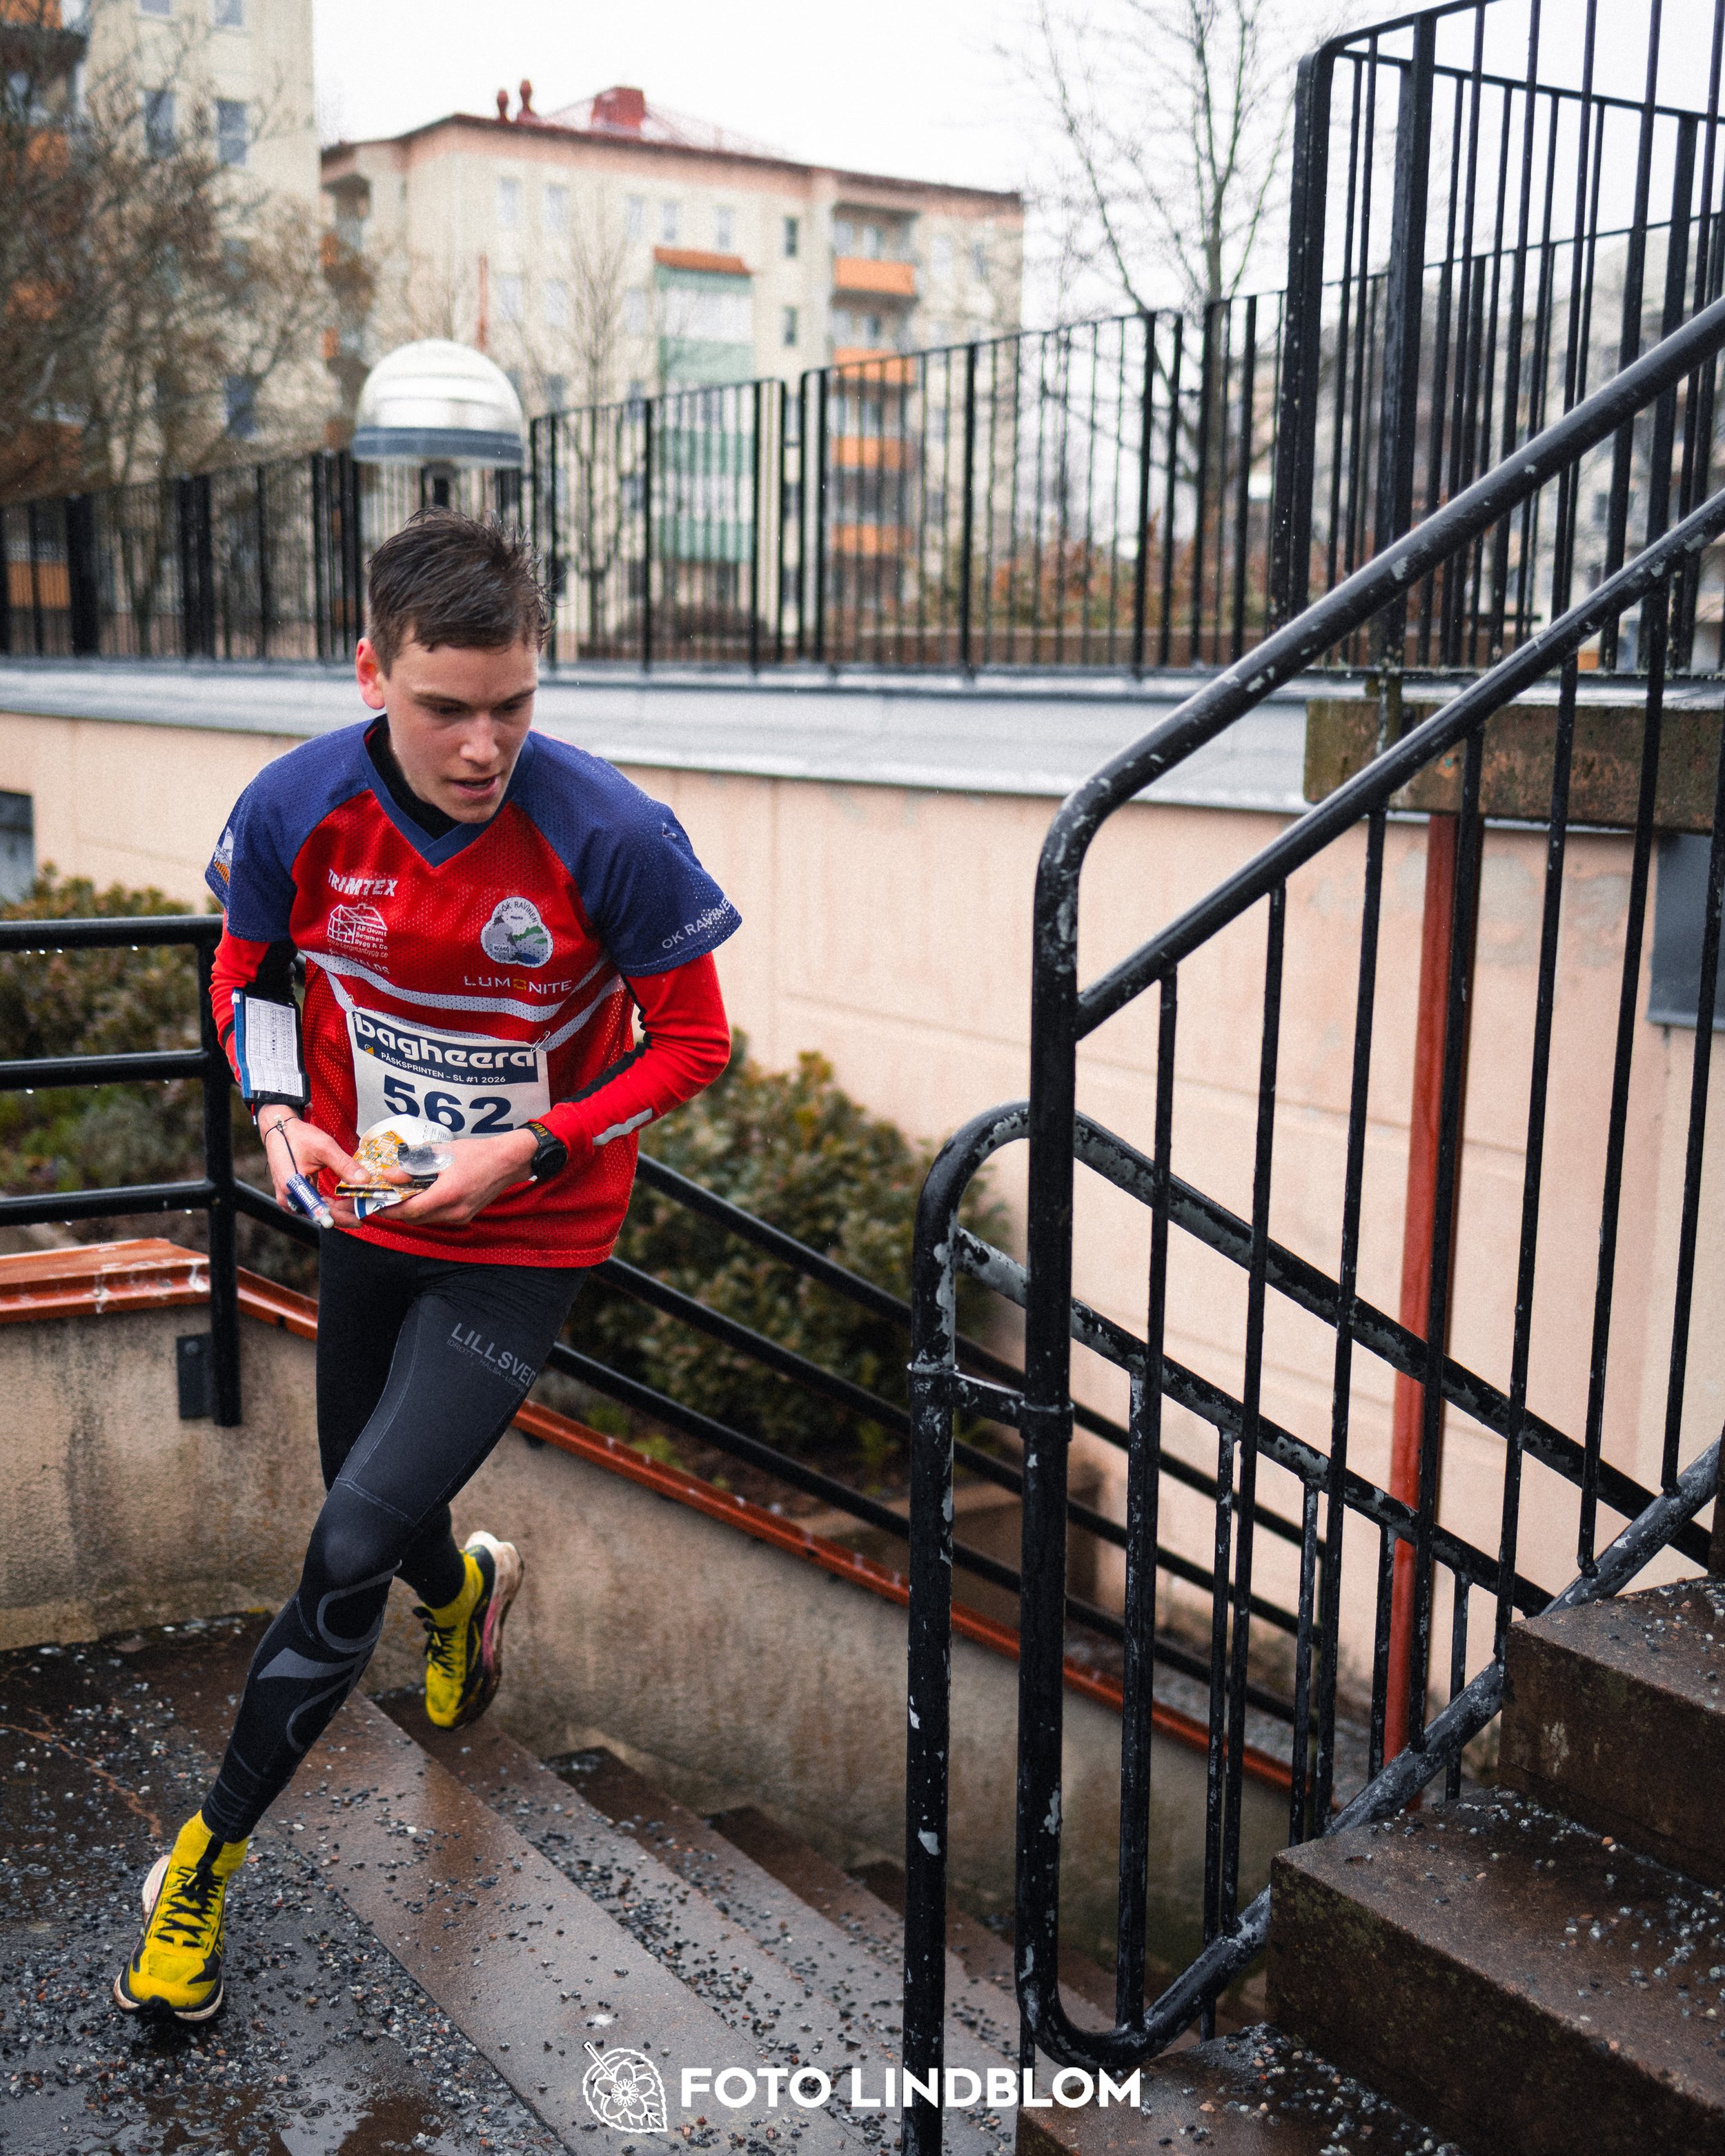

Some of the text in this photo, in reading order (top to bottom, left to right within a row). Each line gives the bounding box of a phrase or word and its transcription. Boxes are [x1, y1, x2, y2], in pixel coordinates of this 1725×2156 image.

[328, 868, 398, 898] TRIMTEX
[502, 901, 538, 923] OK RAVINEN
[355, 932, 384, 942] Bergman
[355, 939, 371, 948] Bygg
[662, 930, 684, 949] OK
[464, 976, 572, 994] LUMONITE
[356, 1012, 535, 1069] bagheera
[381, 1051, 444, 1078] PÅSKSPRINTEN
[453, 1074, 464, 1082] SL
[383, 1074, 514, 1134] 562
[446, 1338, 475, 1358] IDROTT
